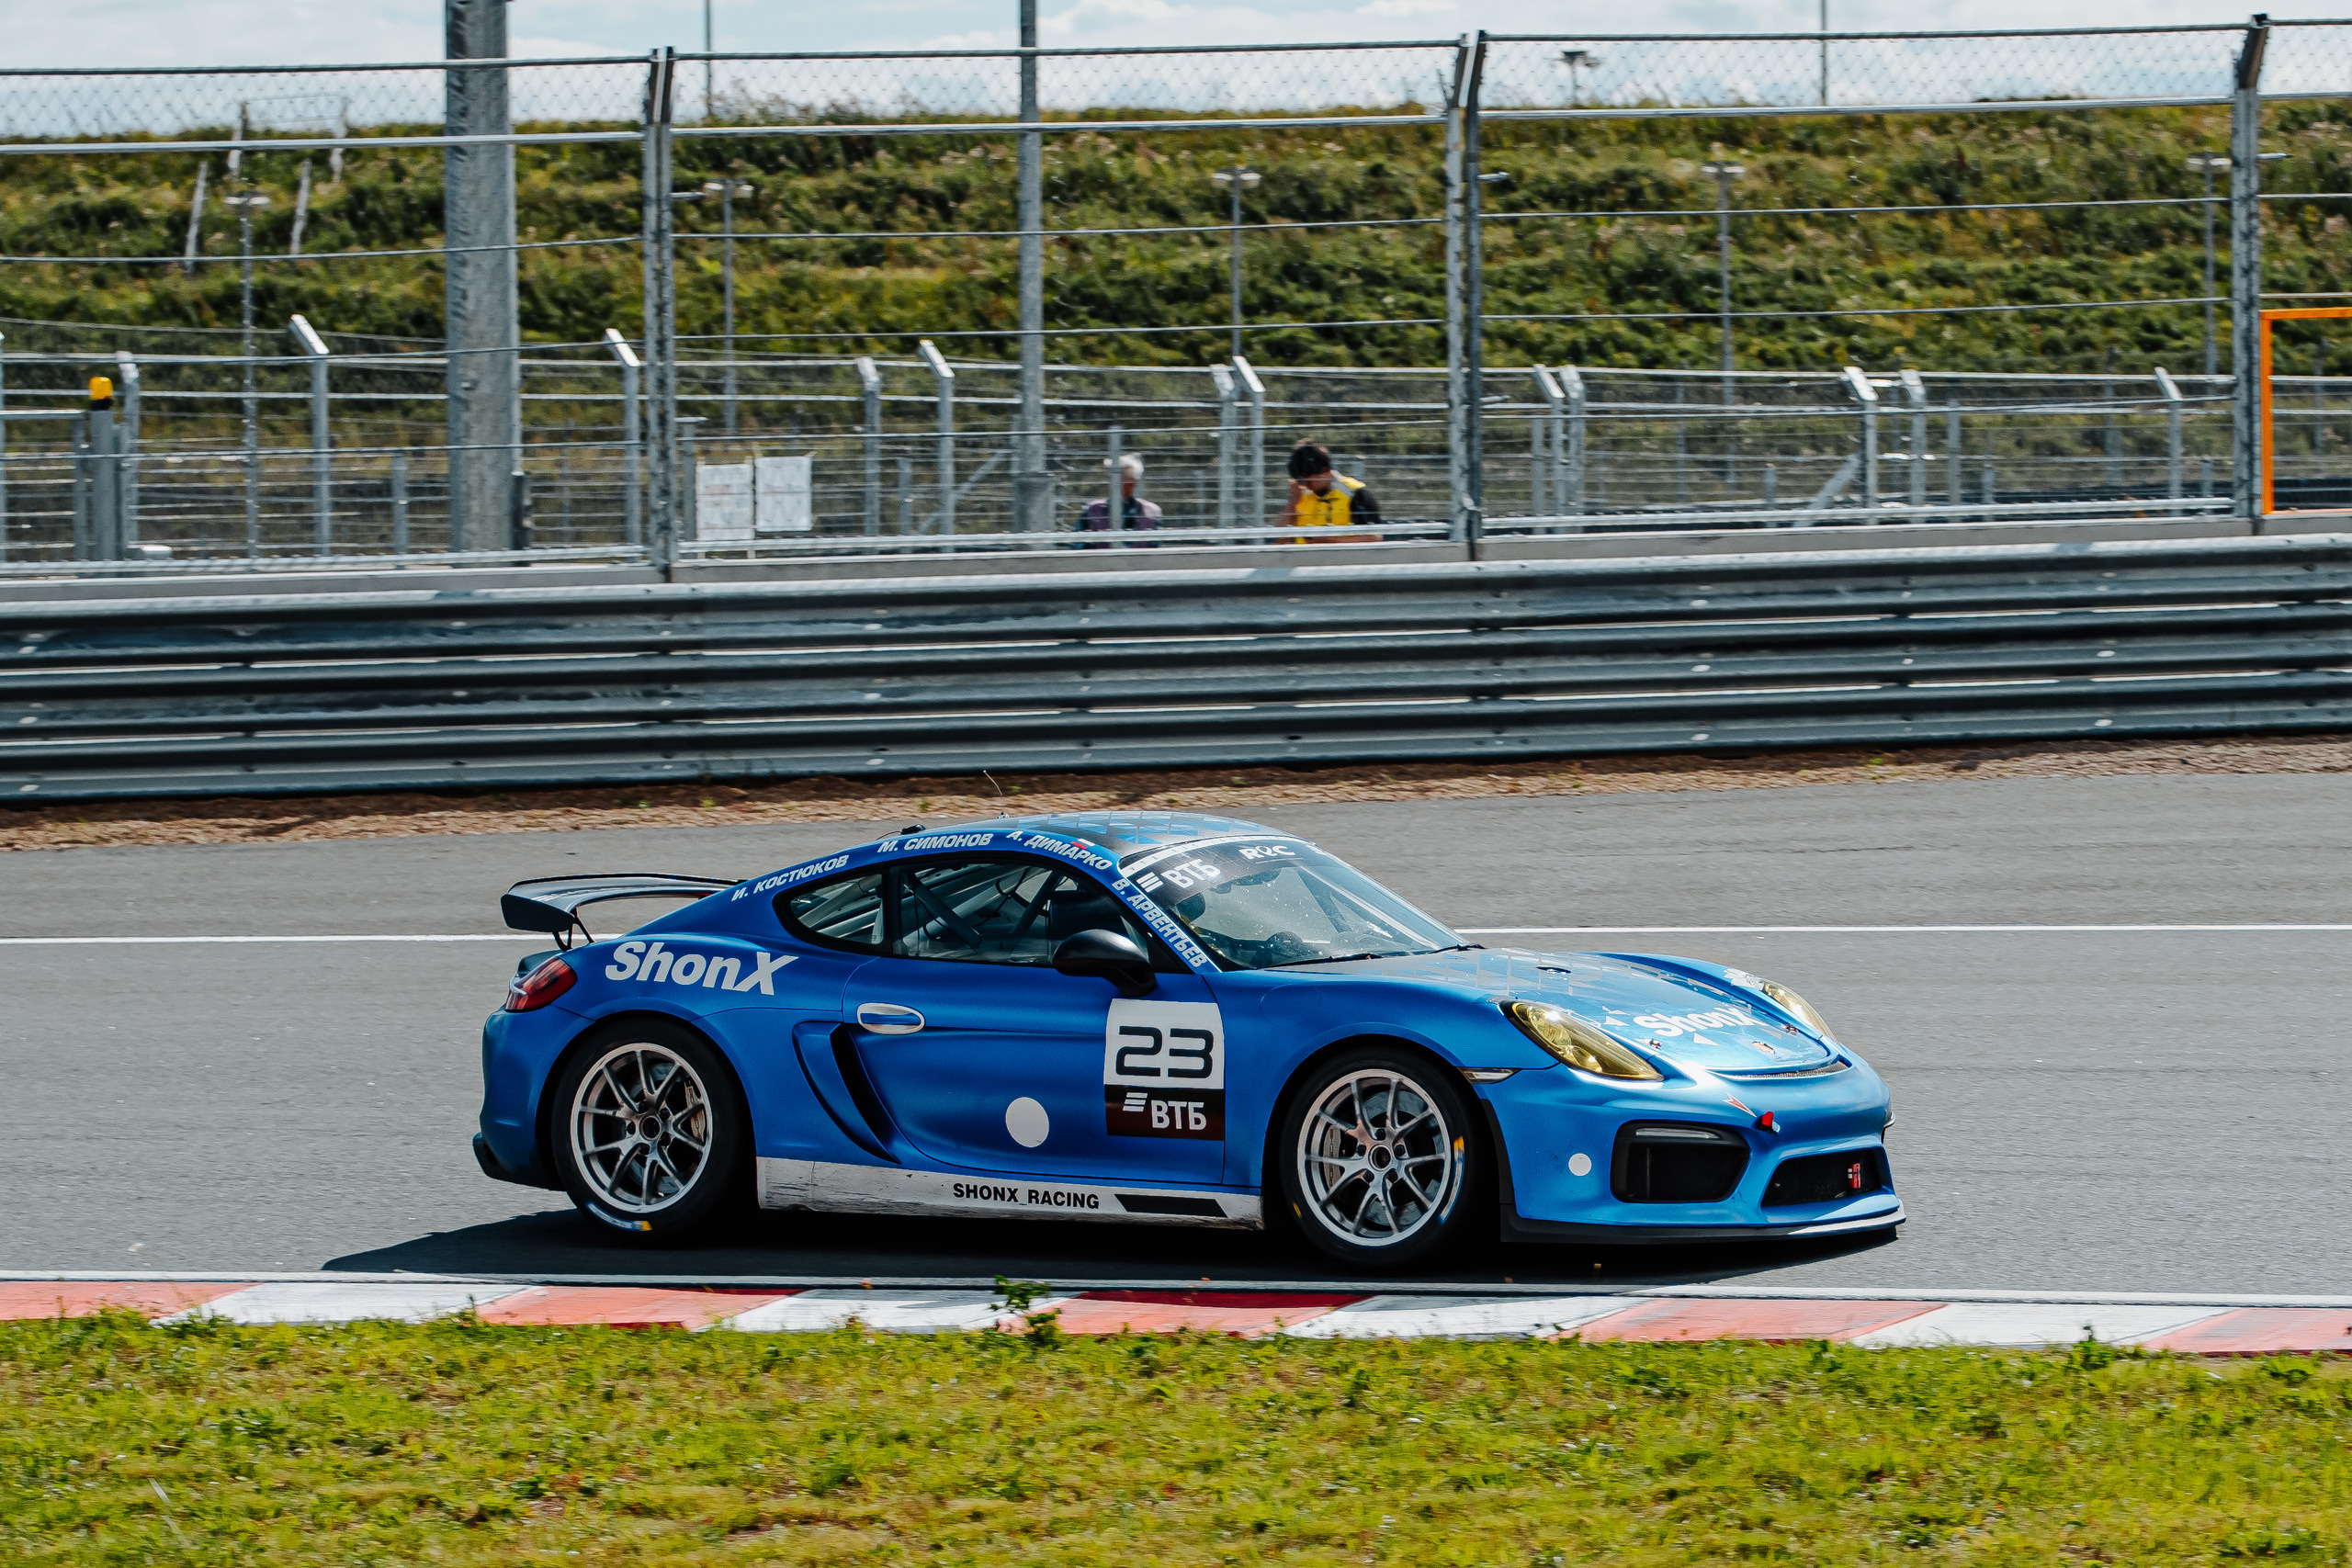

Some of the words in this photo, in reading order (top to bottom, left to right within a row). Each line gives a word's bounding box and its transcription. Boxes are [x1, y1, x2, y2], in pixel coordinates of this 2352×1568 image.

[877, 837, 899, 853] М.
[903, 832, 994, 852] СИМОНОВ
[1006, 830, 1023, 843] А.
[1023, 835, 1114, 870] ДИМАРКО
[753, 854, 850, 894] КОСТЮКОВ
[1160, 859, 1223, 890] ВТБ
[1112, 878, 1125, 897] В.
[1126, 894, 1209, 968] АРВЕНТЬЕВ
[605, 941, 800, 996] ShonX
[1114, 1025, 1215, 1079] 23
[1150, 1100, 1208, 1131] ВТБ
